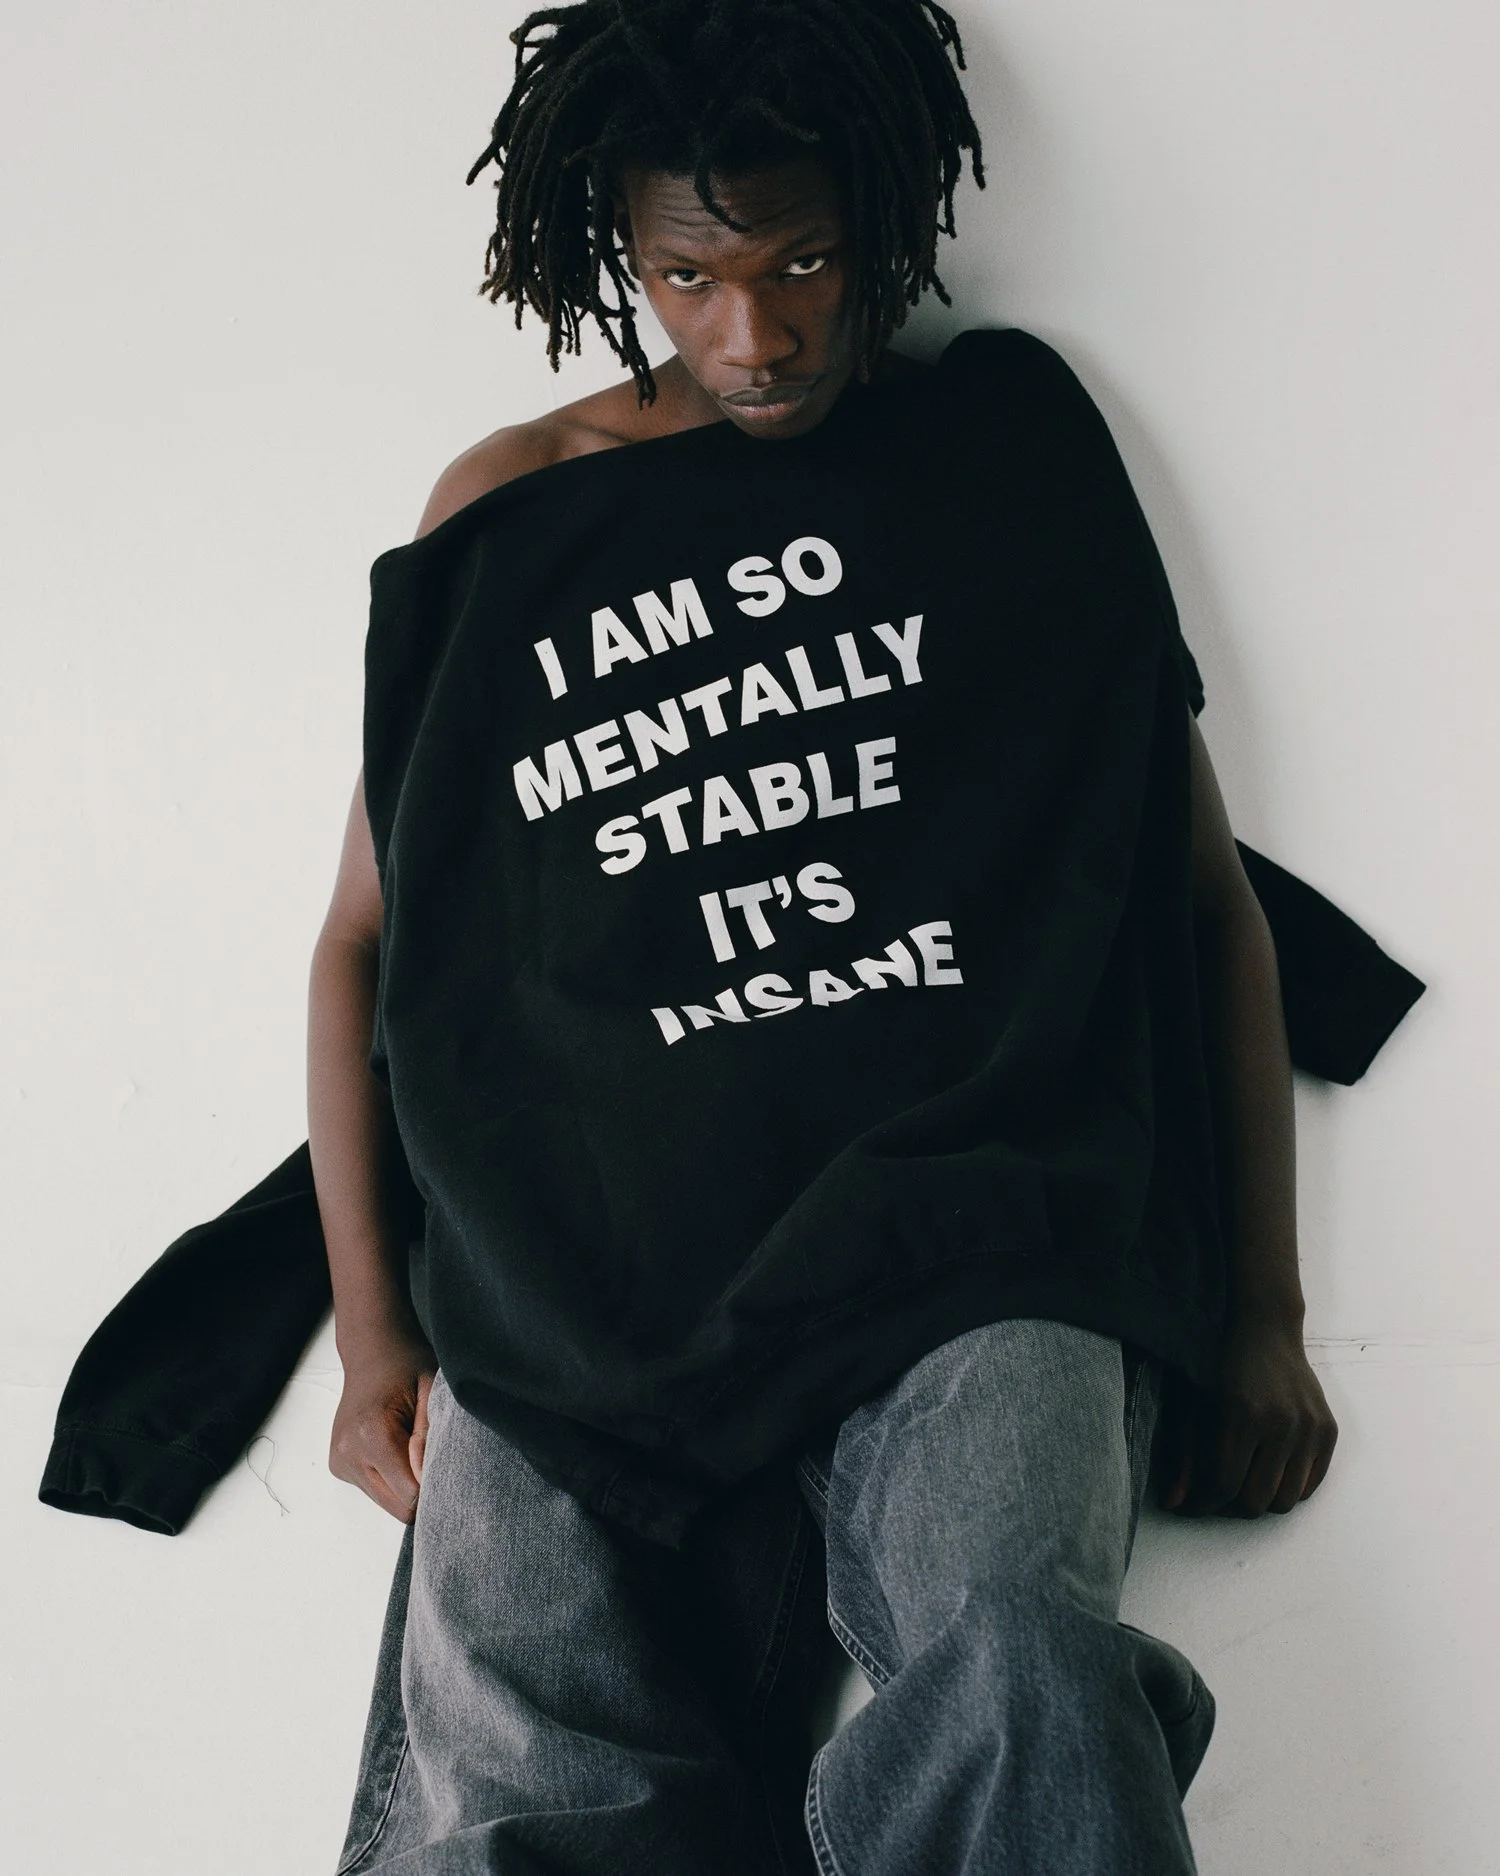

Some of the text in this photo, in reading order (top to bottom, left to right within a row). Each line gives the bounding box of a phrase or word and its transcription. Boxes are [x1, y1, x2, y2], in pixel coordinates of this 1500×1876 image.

[534, 536, 843, 701] I AM SO
[512, 614, 924, 822] MENTALLY
[594, 736, 902, 876] STABLE
[698, 862, 856, 963] IT'S
[650, 920, 964, 1046] INSANE
